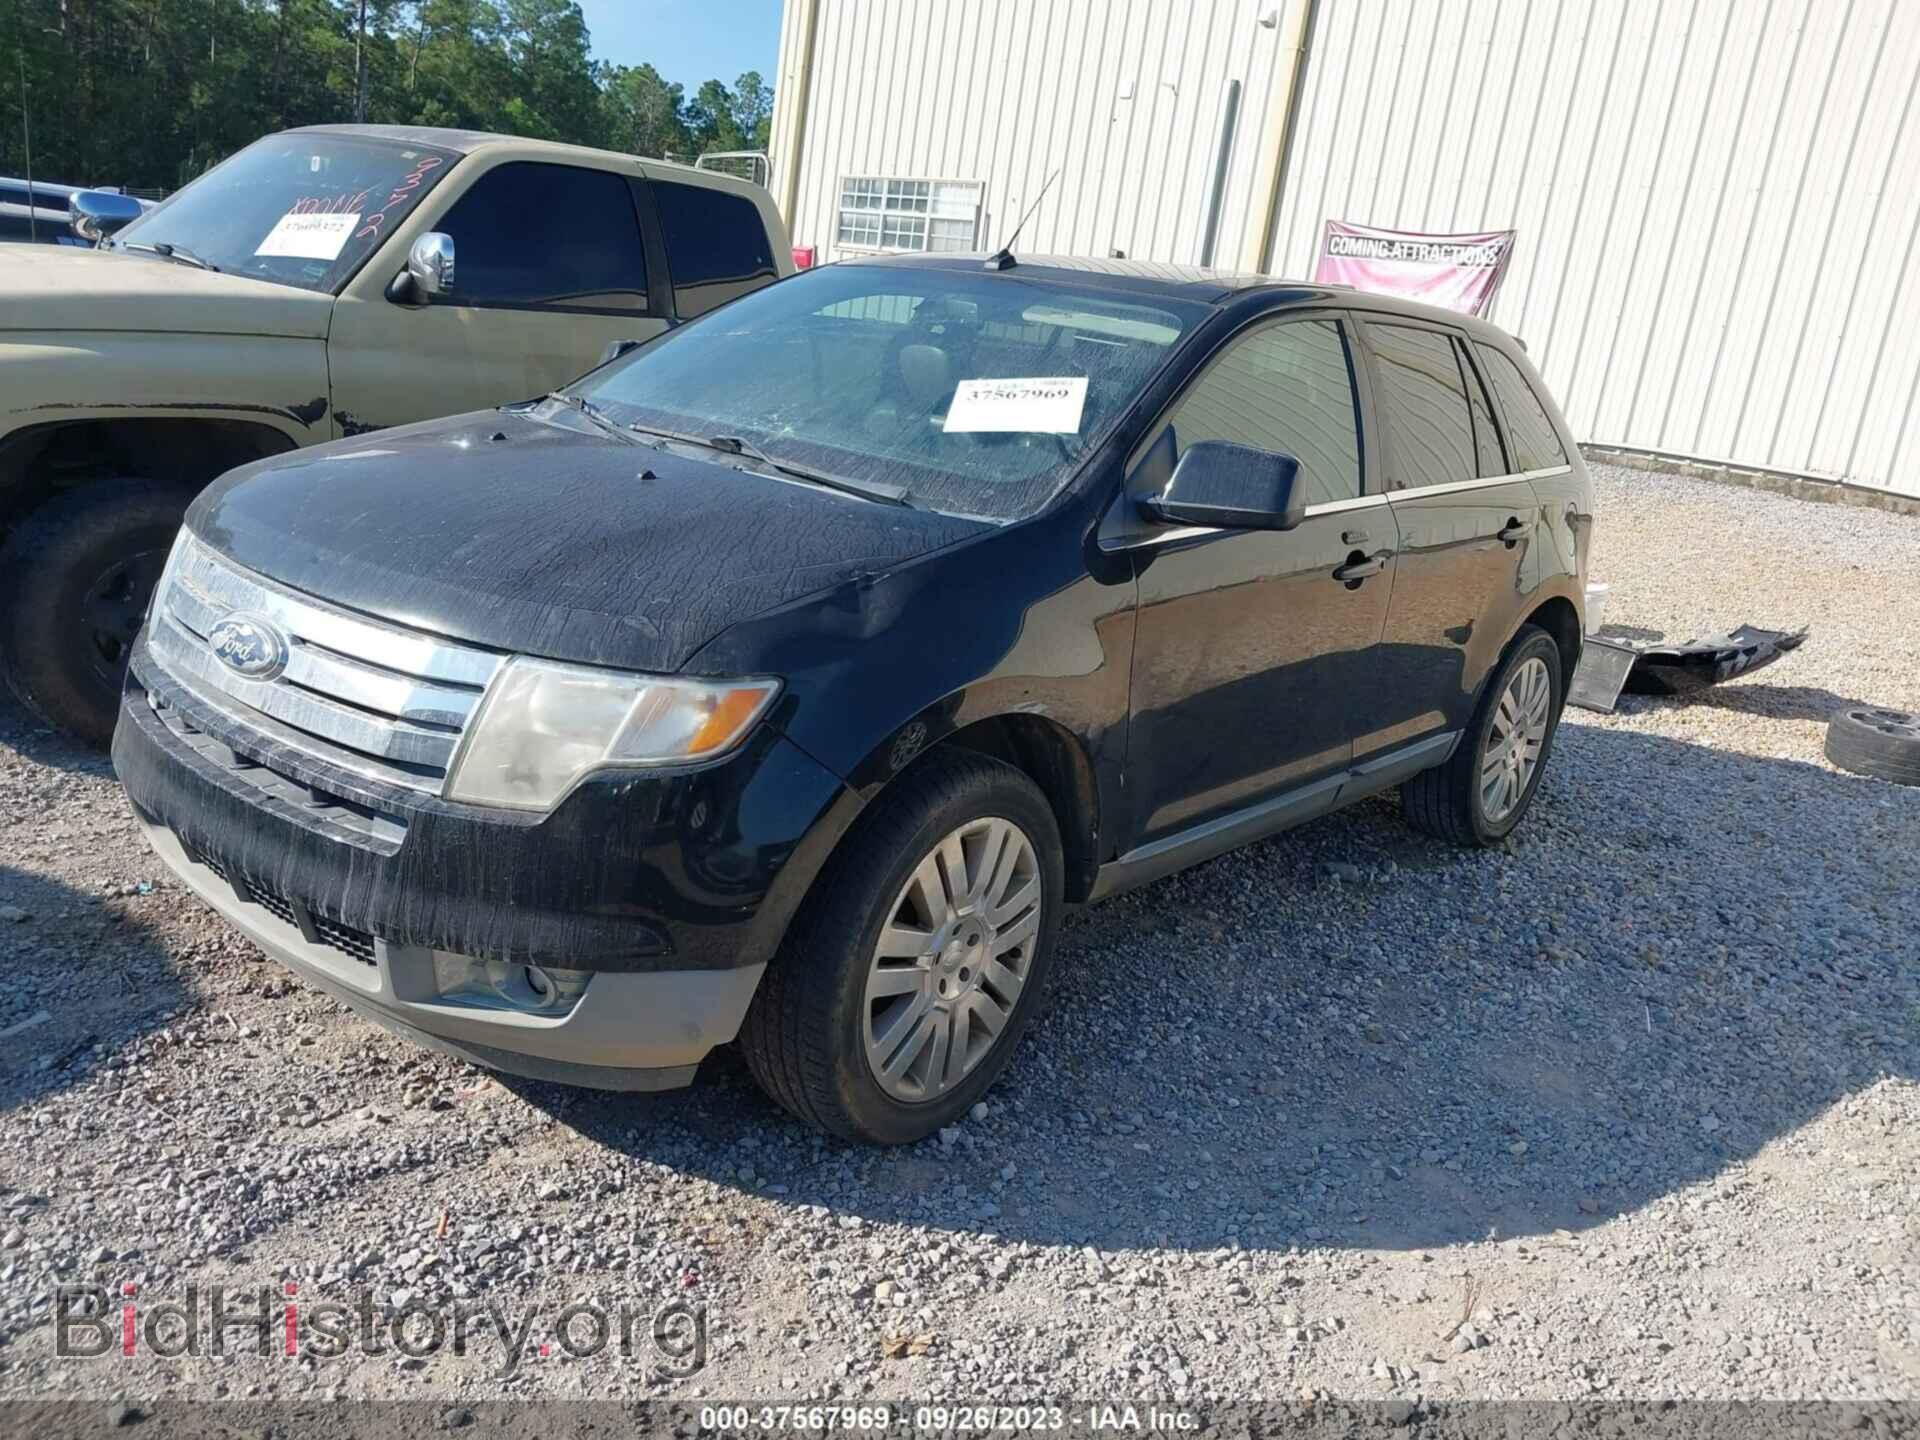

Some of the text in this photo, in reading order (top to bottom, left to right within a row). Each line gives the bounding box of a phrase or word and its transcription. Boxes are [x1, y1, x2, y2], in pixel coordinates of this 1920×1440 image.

[1330, 236, 1388, 257] COMING
[967, 389, 1070, 401] 37567969
[215, 623, 256, 660] Ford
